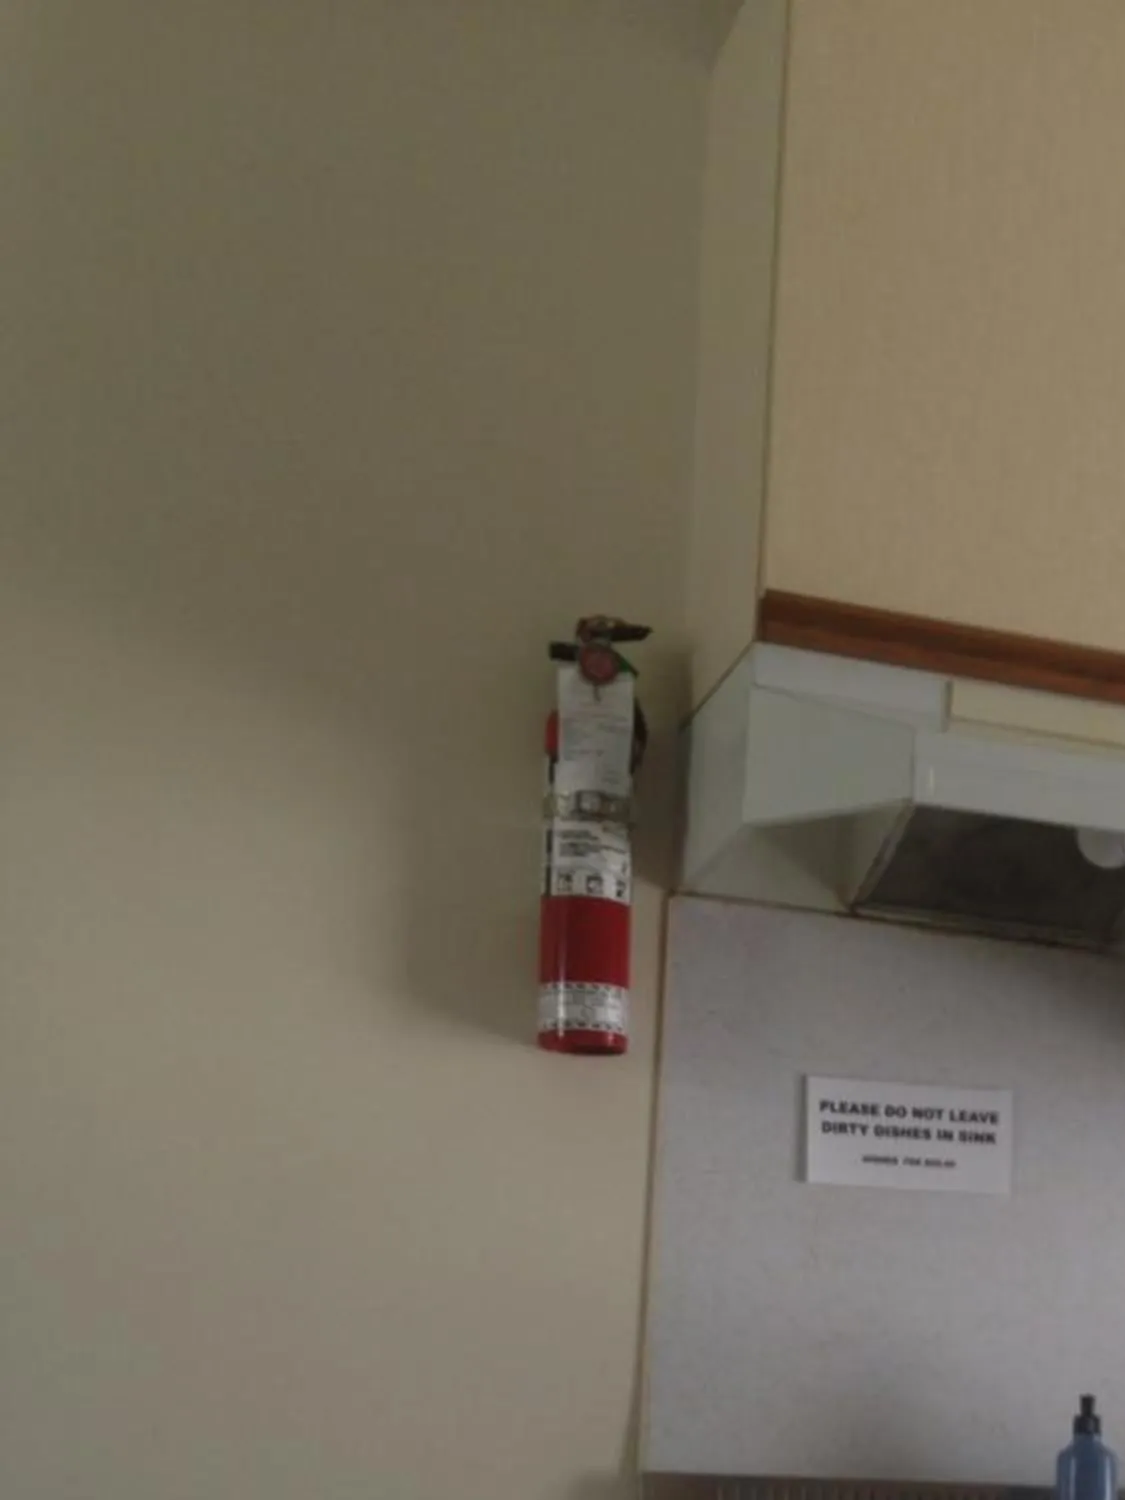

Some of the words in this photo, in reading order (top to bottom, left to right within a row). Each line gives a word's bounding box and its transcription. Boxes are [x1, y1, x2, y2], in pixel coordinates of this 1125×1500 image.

[819, 1100, 880, 1117] PLEASE
[884, 1104, 908, 1119] DO
[912, 1106, 944, 1121] NOT
[949, 1109, 999, 1125] LEAVE
[821, 1120, 869, 1137] DIRTY
[873, 1124, 931, 1141] DISHES
[937, 1128, 953, 1142] IN
[958, 1130, 996, 1145] SINK
